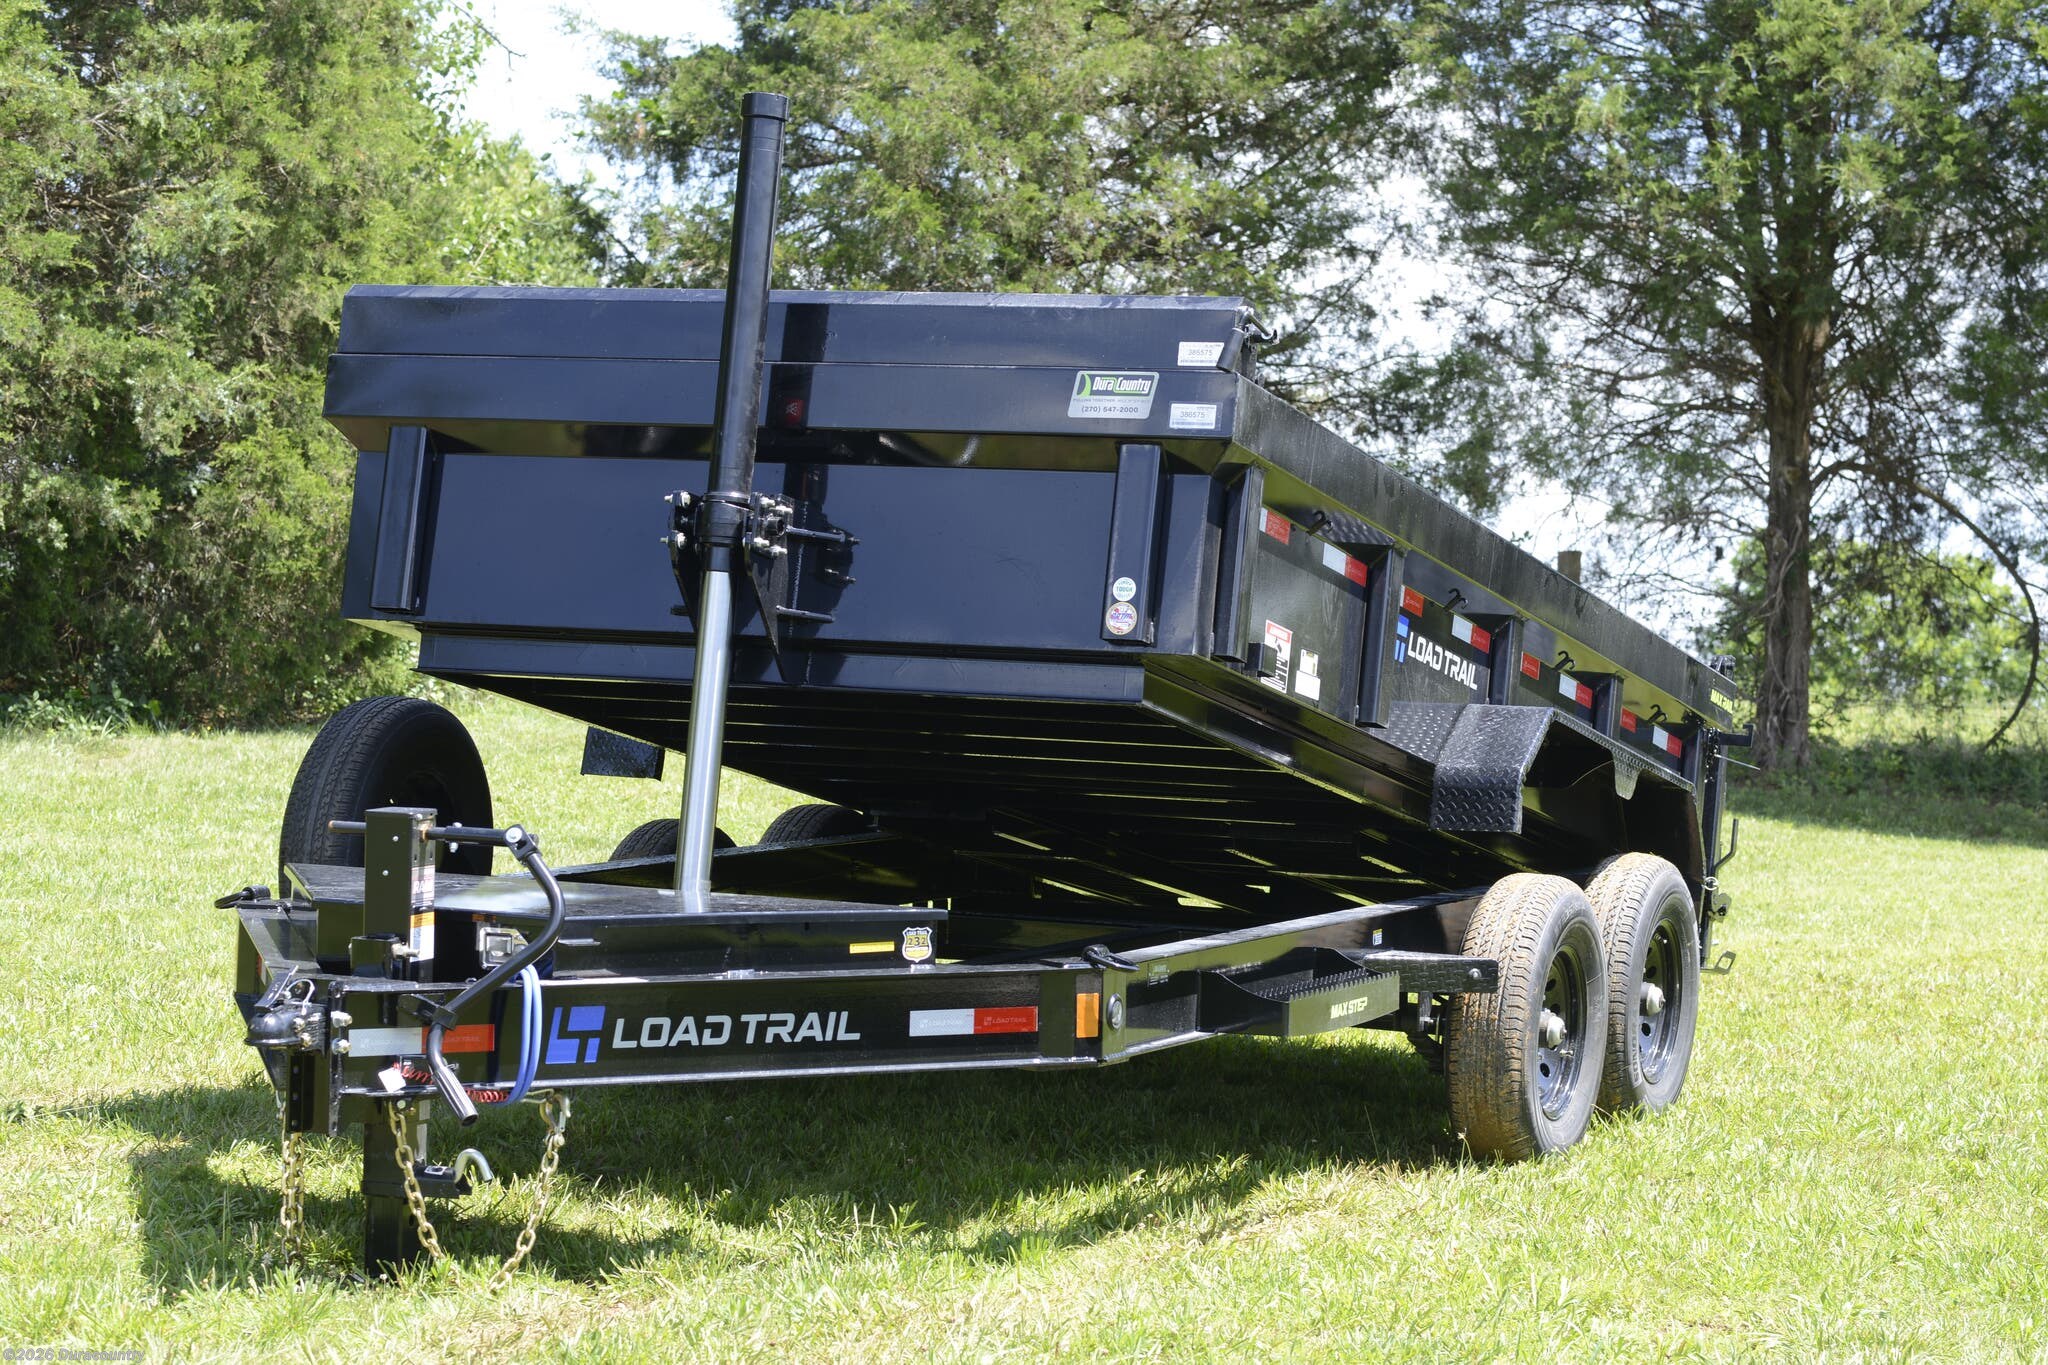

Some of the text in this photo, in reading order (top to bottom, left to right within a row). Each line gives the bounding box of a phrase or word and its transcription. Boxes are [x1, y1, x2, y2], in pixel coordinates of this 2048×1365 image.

[1092, 376, 1152, 394] Dura Country
[1407, 632, 1443, 671] LOAD
[1444, 650, 1478, 691] TRAIL
[1330, 996, 1368, 1019] MAX STEP
[612, 1010, 861, 1048] LOAD TRAIL
